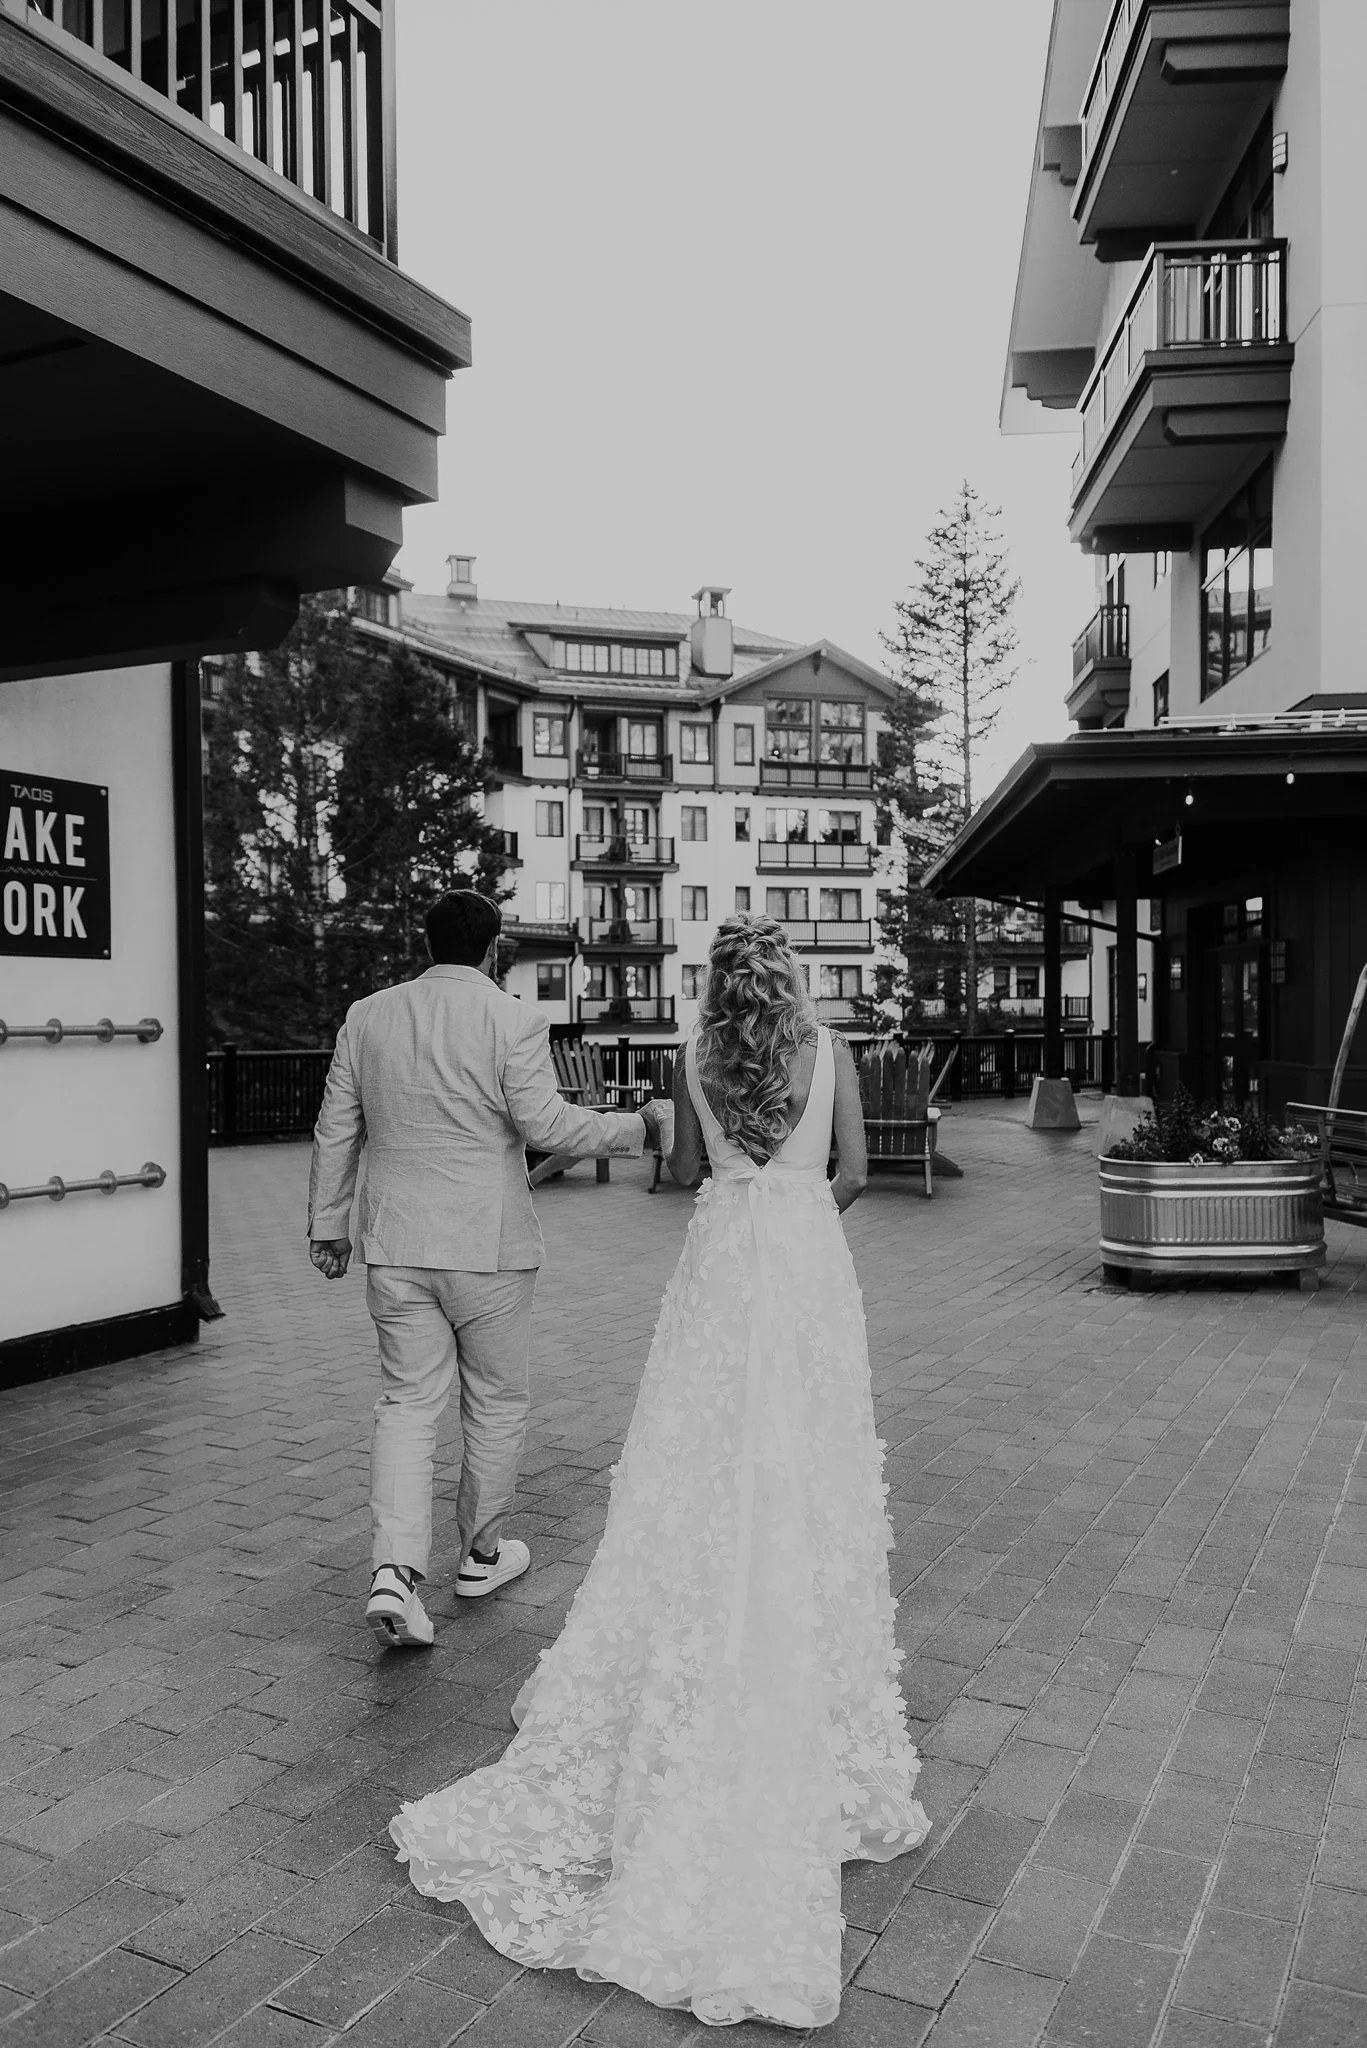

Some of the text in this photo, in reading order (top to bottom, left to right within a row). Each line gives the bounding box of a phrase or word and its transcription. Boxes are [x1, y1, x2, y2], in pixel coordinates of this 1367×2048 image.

[10, 784, 53, 803] TAOS
[4, 806, 86, 867] AKE
[3, 880, 87, 938] ORK
